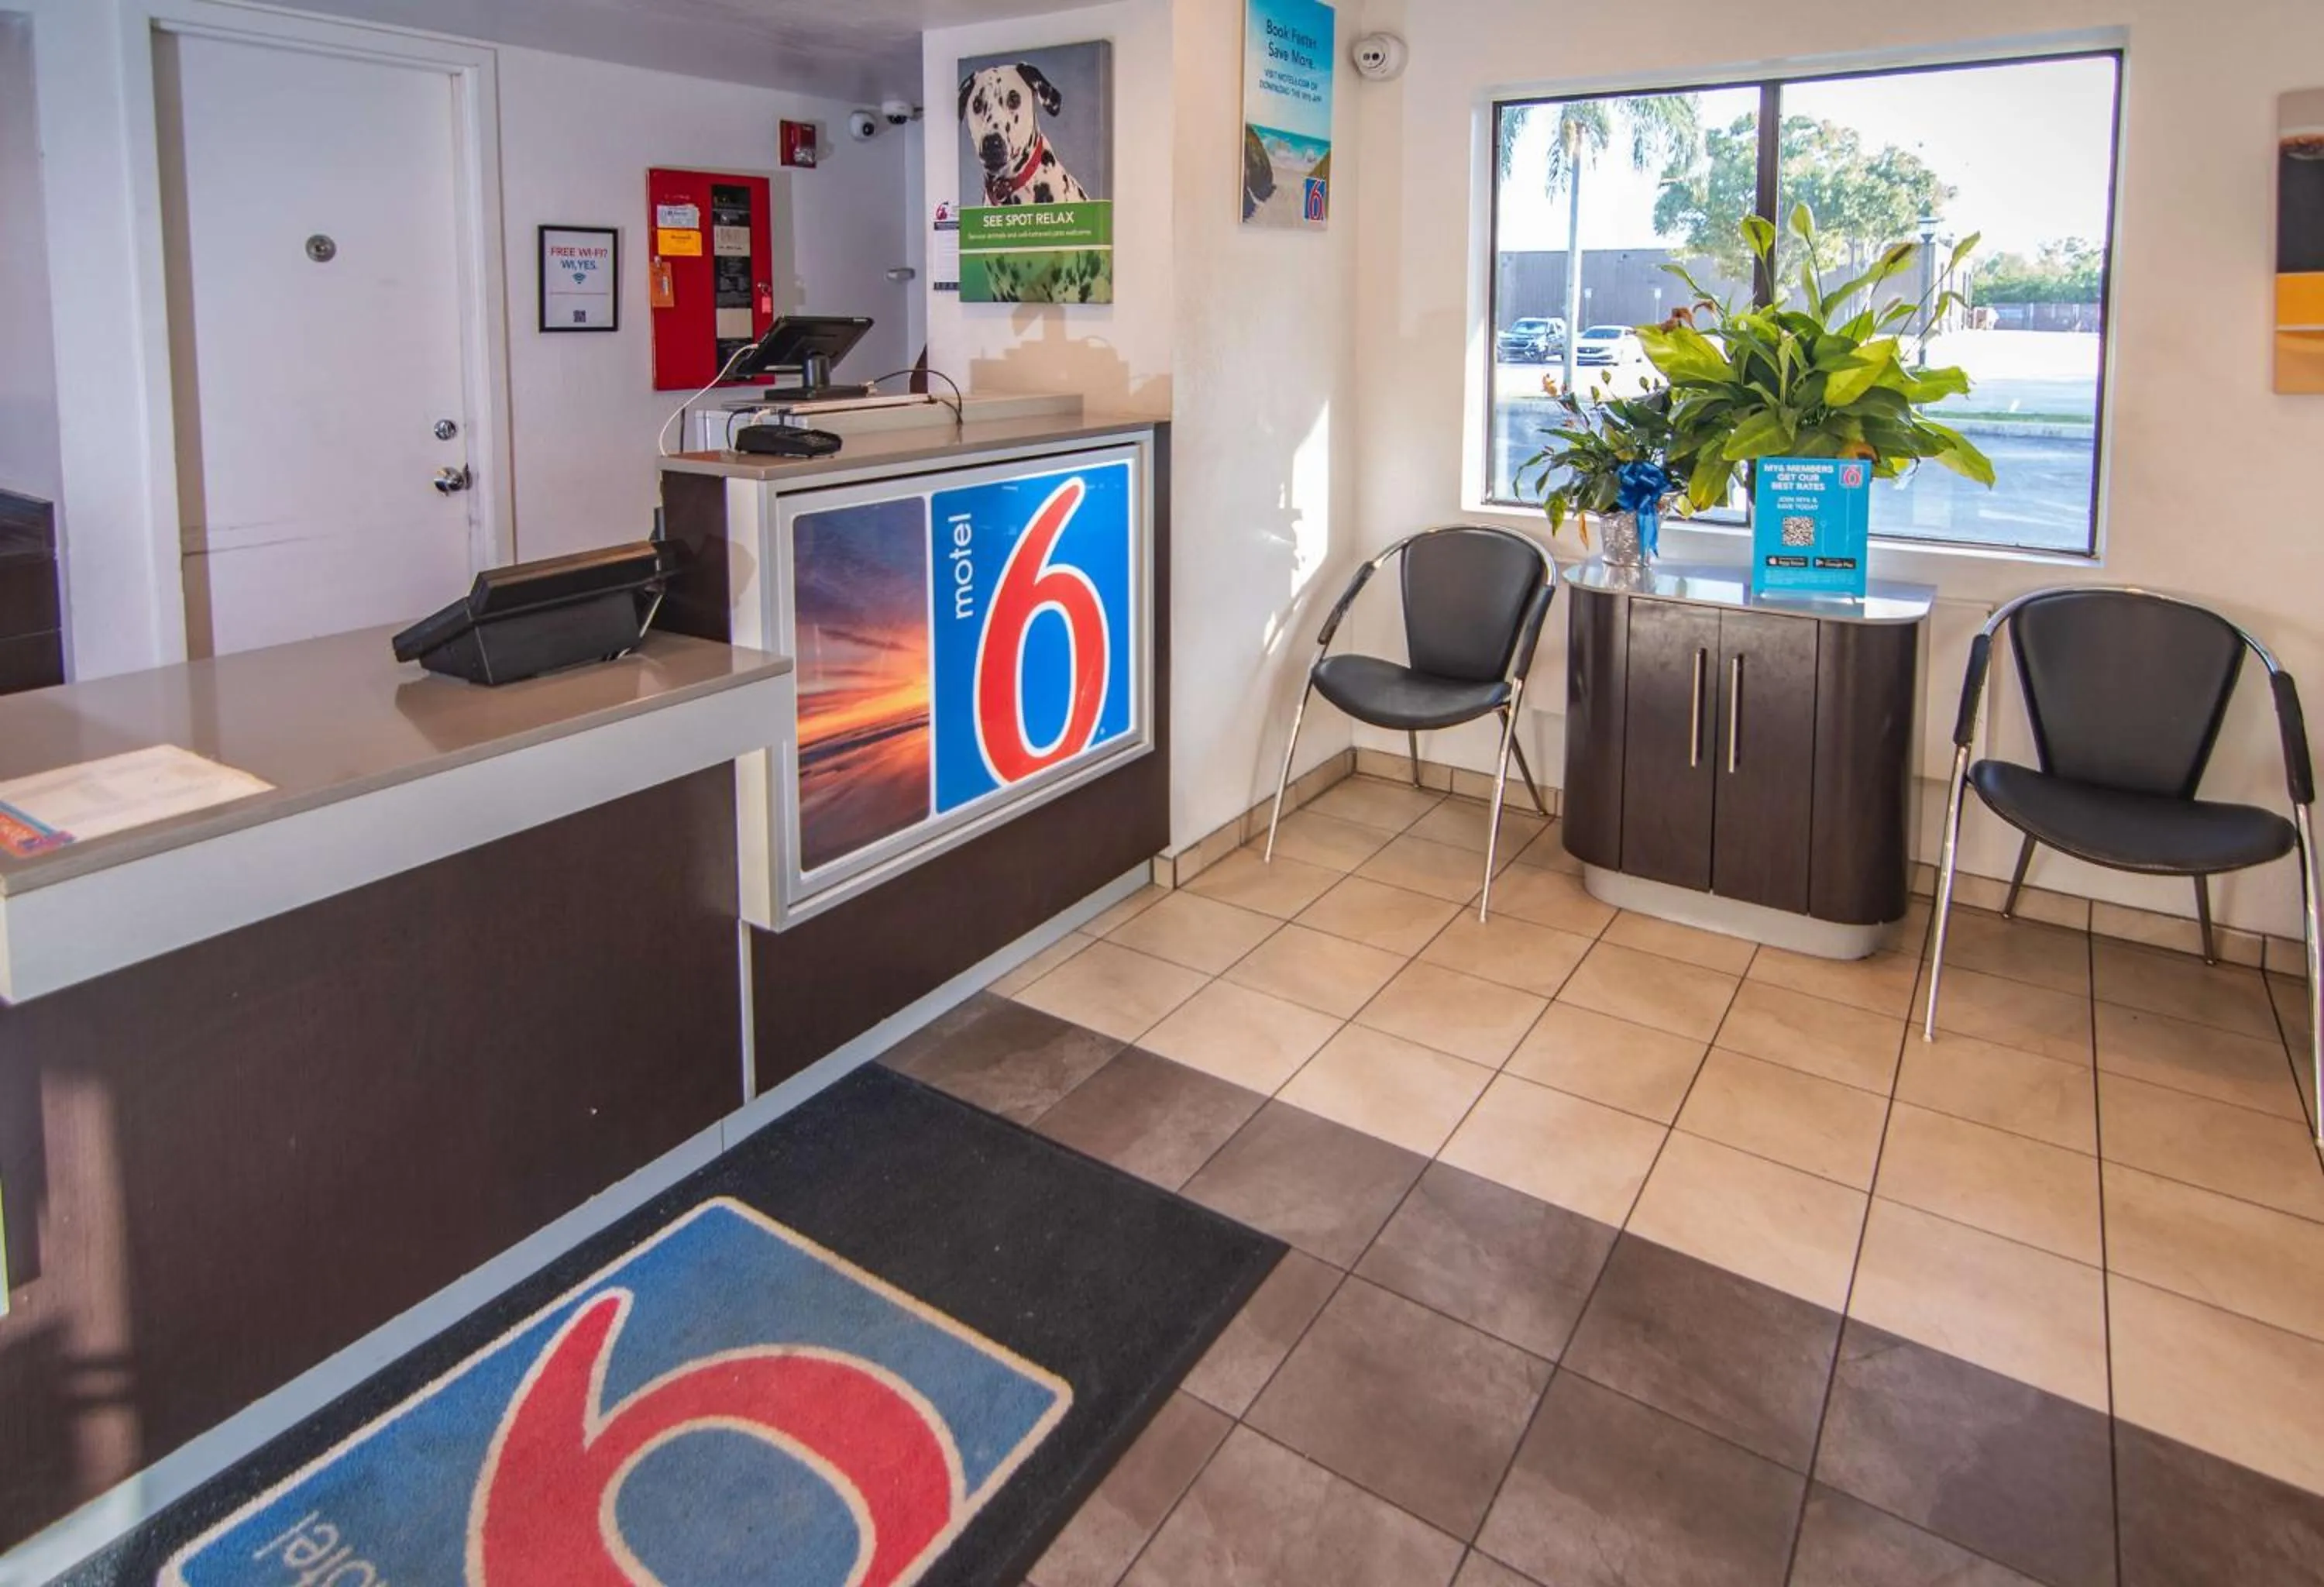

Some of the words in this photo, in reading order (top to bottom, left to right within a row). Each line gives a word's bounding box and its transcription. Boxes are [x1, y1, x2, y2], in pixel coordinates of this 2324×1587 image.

[1267, 19, 1289, 39] Book
[1291, 27, 1318, 50] Faster
[1268, 41, 1289, 61] Save
[1291, 49, 1315, 70] More.
[1264, 68, 1277, 78] VISIT
[1259, 79, 1291, 95] DOWNLOAD
[1308, 179, 1325, 222] 6
[983, 214, 1003, 227] SEE
[1006, 214, 1033, 226] SPOT
[1036, 211, 1075, 225] RELAX
[550, 246, 576, 256] FREE
[578, 247, 609, 258] WI-FI?
[1776, 473, 1797, 482] GET
[1798, 473, 1820, 482] OUR
[1786, 464, 1834, 473] MEMBERS
[1843, 465, 1861, 487] 6
[1771, 481, 1796, 491] BEST
[1796, 482, 1826, 491] RATES
[947, 512, 975, 620] motel
[973, 477, 1111, 789] 6
[466, 1288, 968, 1587] 6
[253, 1510, 387, 1587] otel
